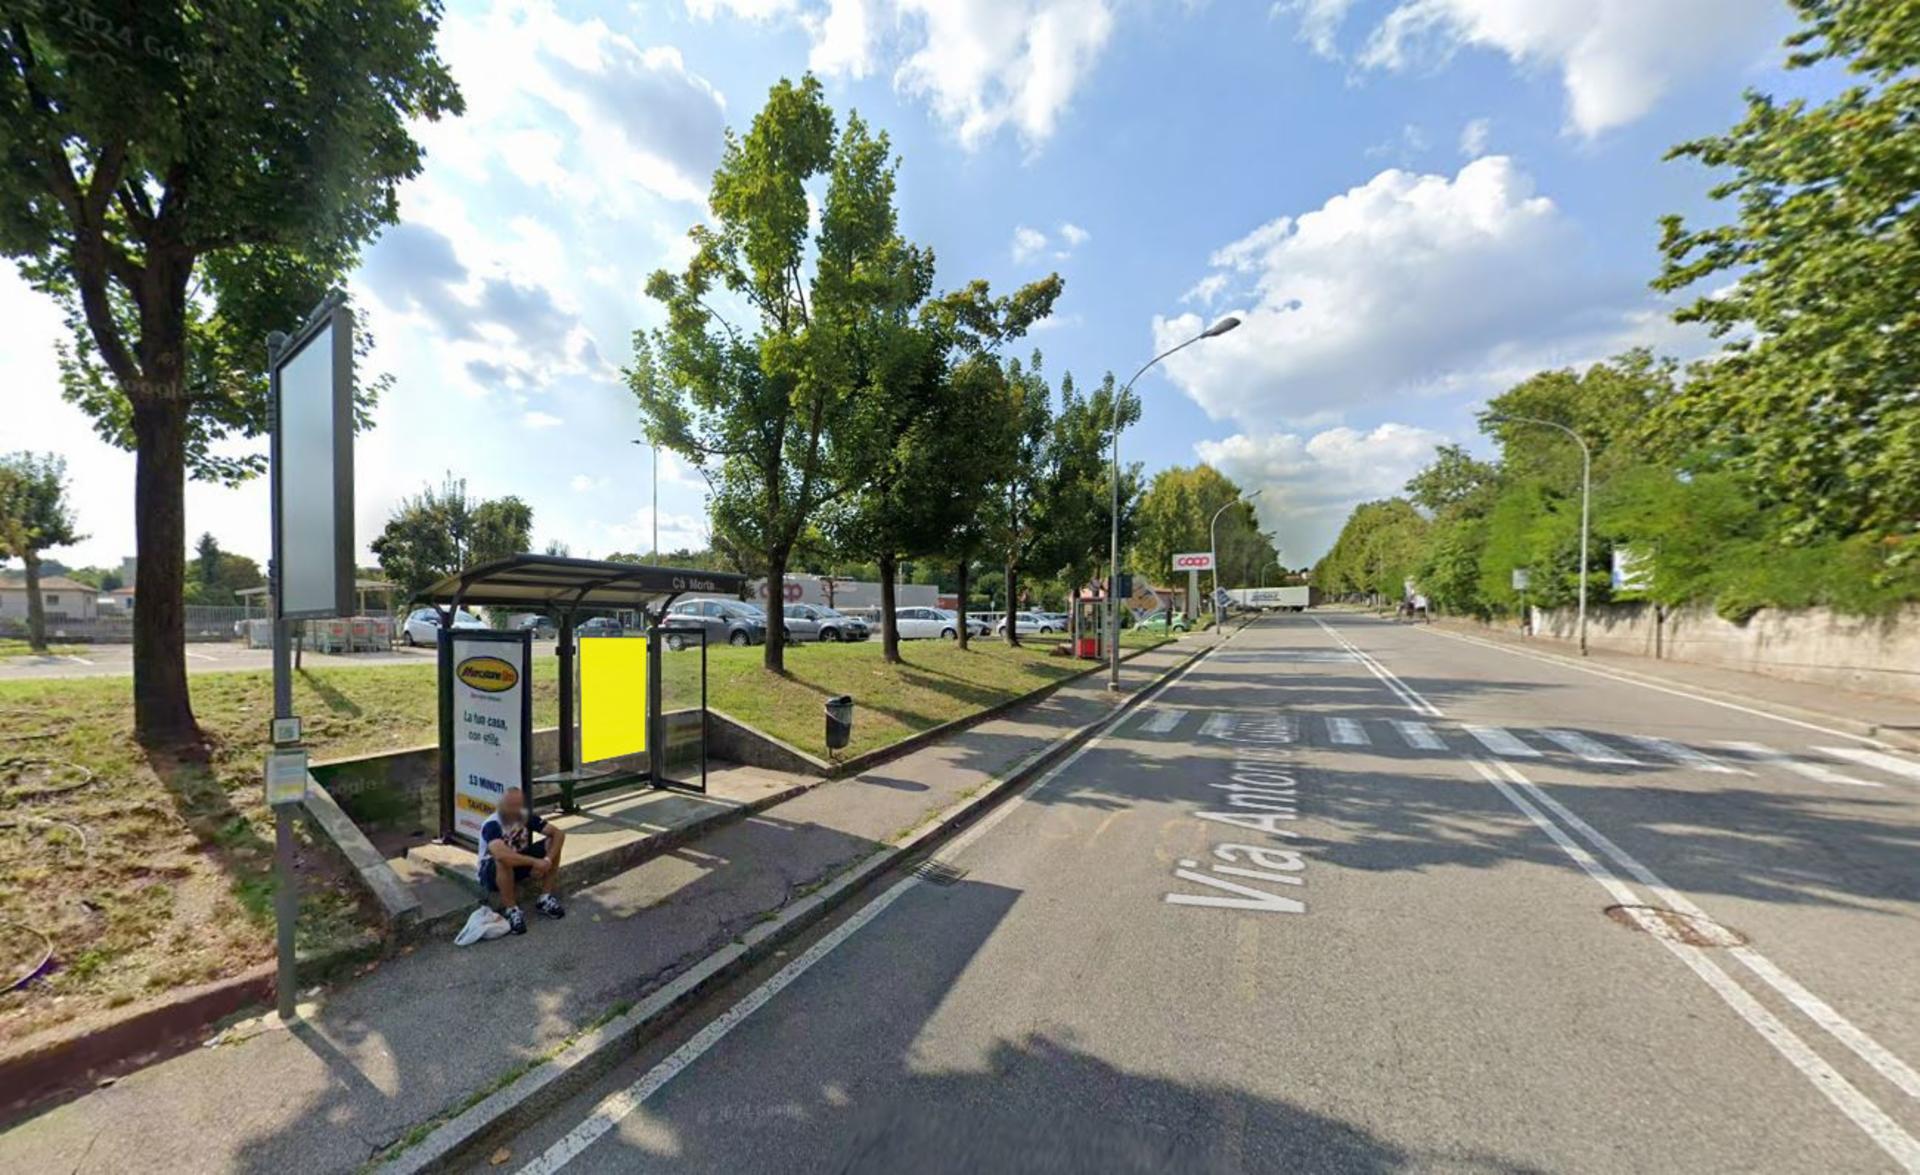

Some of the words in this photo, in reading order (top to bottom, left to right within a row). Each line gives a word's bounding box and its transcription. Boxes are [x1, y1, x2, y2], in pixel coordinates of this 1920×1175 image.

[1178, 557, 1210, 568] coop
[464, 710, 473, 723] La
[469, 774, 478, 786] 13
[479, 777, 504, 793] MINUTI
